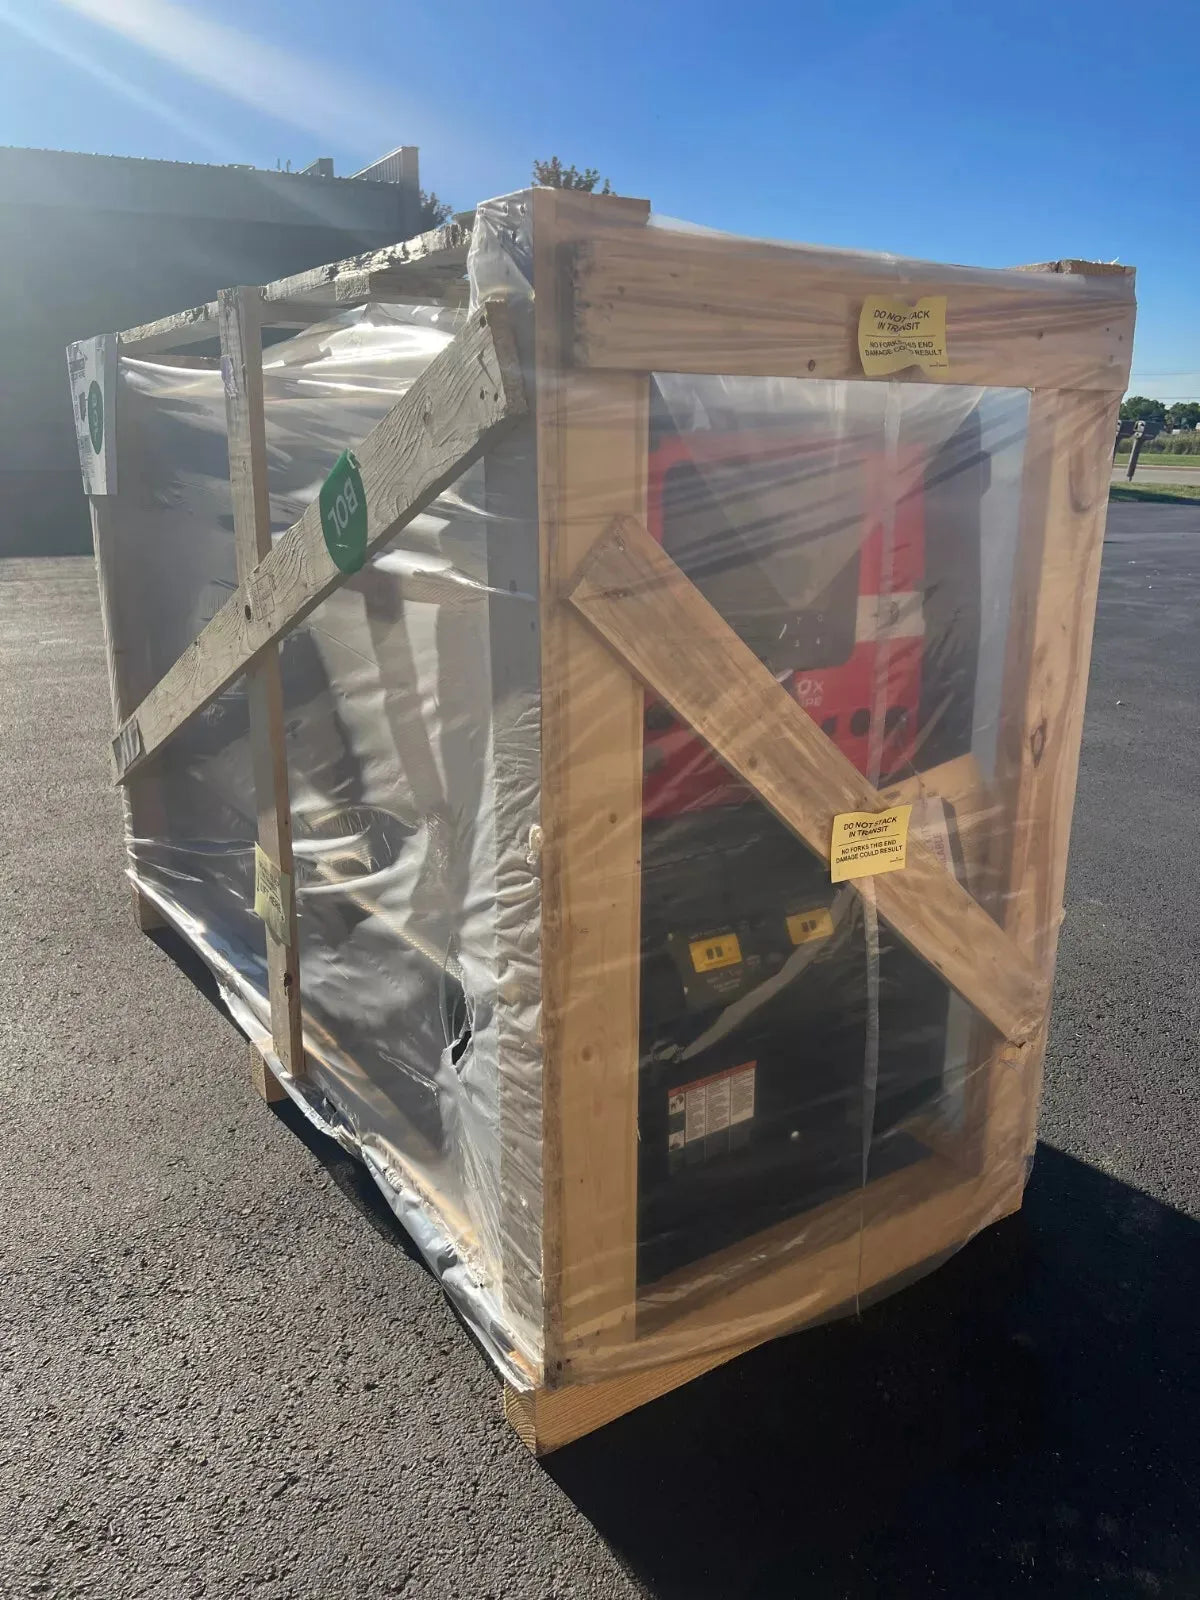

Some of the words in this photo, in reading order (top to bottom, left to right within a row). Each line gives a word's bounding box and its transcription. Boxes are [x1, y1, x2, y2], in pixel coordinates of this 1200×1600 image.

[874, 309, 887, 319] DO
[887, 312, 907, 323] NOT
[877, 322, 886, 330] IN
[887, 321, 921, 333] TRANSIT
[864, 349, 893, 357] DAMAGE
[327, 477, 359, 537] BOL
[843, 822, 855, 831] DO
[855, 821, 874, 829] NOT
[873, 816, 898, 827] STACK
[848, 830, 856, 838] IN
[857, 825, 889, 836] TRANSIT
[850, 844, 870, 853] FORKS
[870, 840, 884, 849] THIS
[835, 853, 859, 864] DAMAGE
[859, 849, 880, 859] COULD
[879, 845, 903, 854] RESULT
